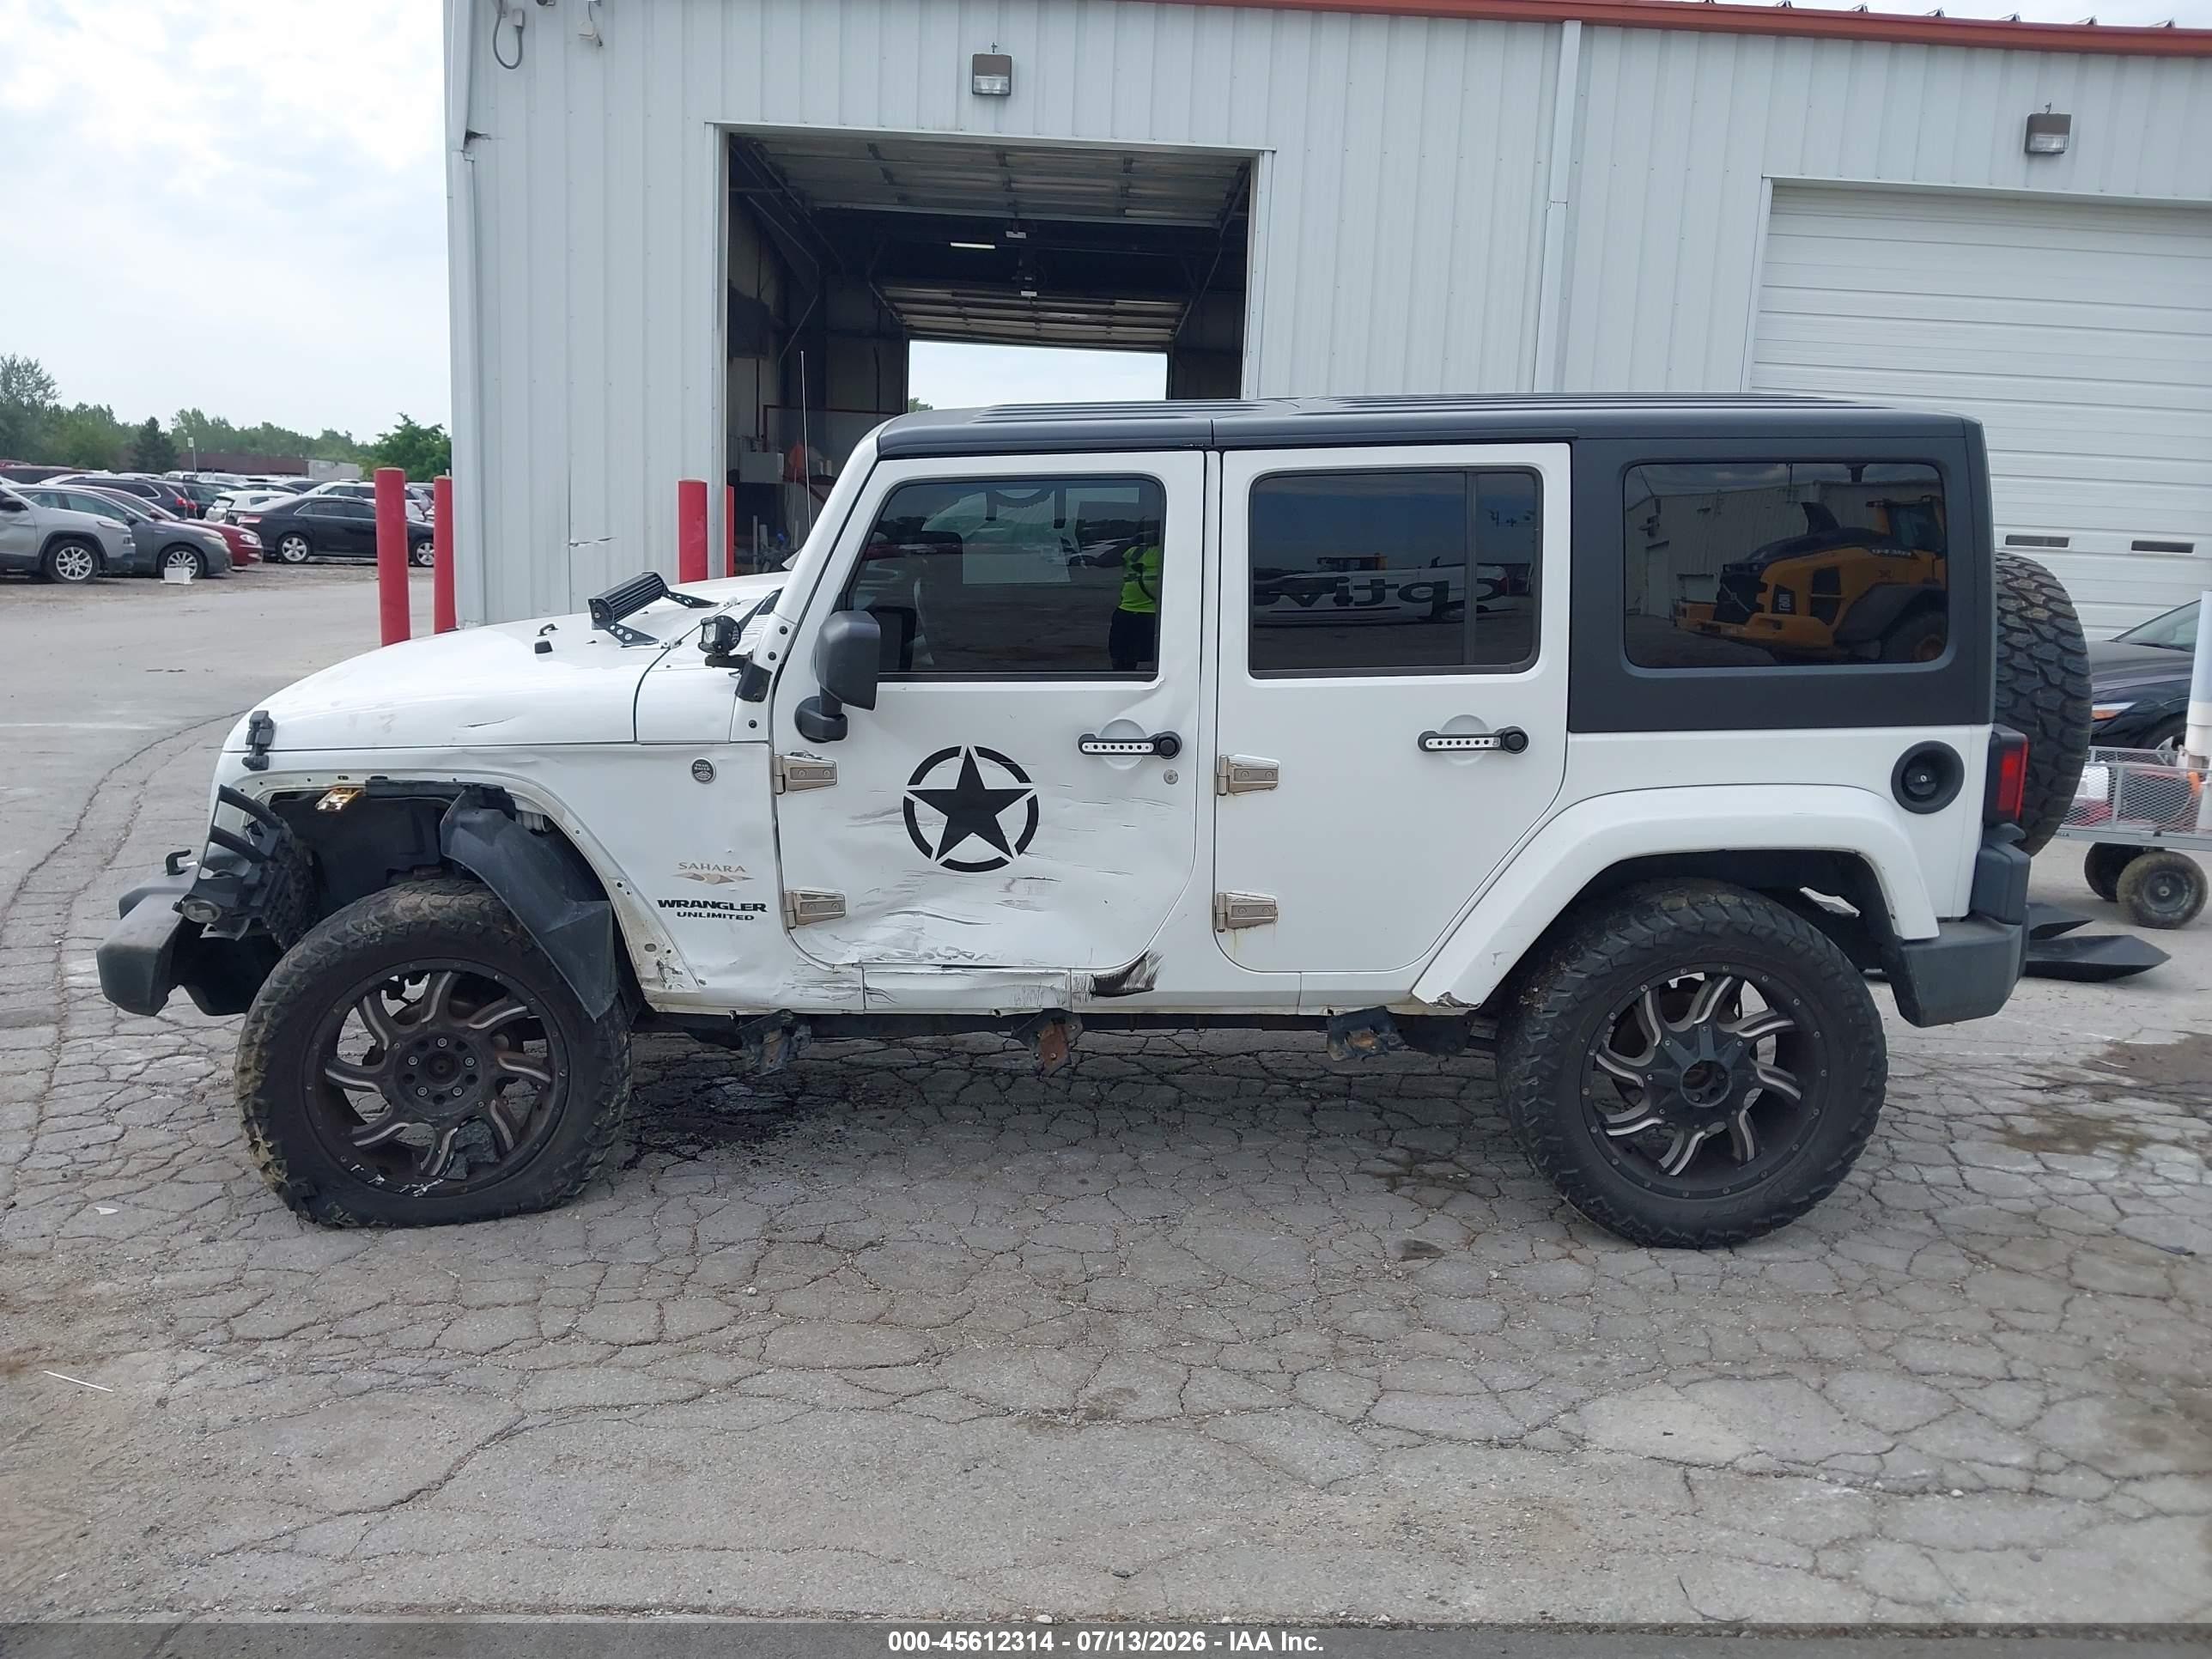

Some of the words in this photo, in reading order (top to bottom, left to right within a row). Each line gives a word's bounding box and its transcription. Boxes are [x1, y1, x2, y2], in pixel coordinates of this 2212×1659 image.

[678, 861, 746, 872] SAHARA
[657, 899, 768, 913] WRANGLER
[677, 911, 755, 921] UNLIMITED
